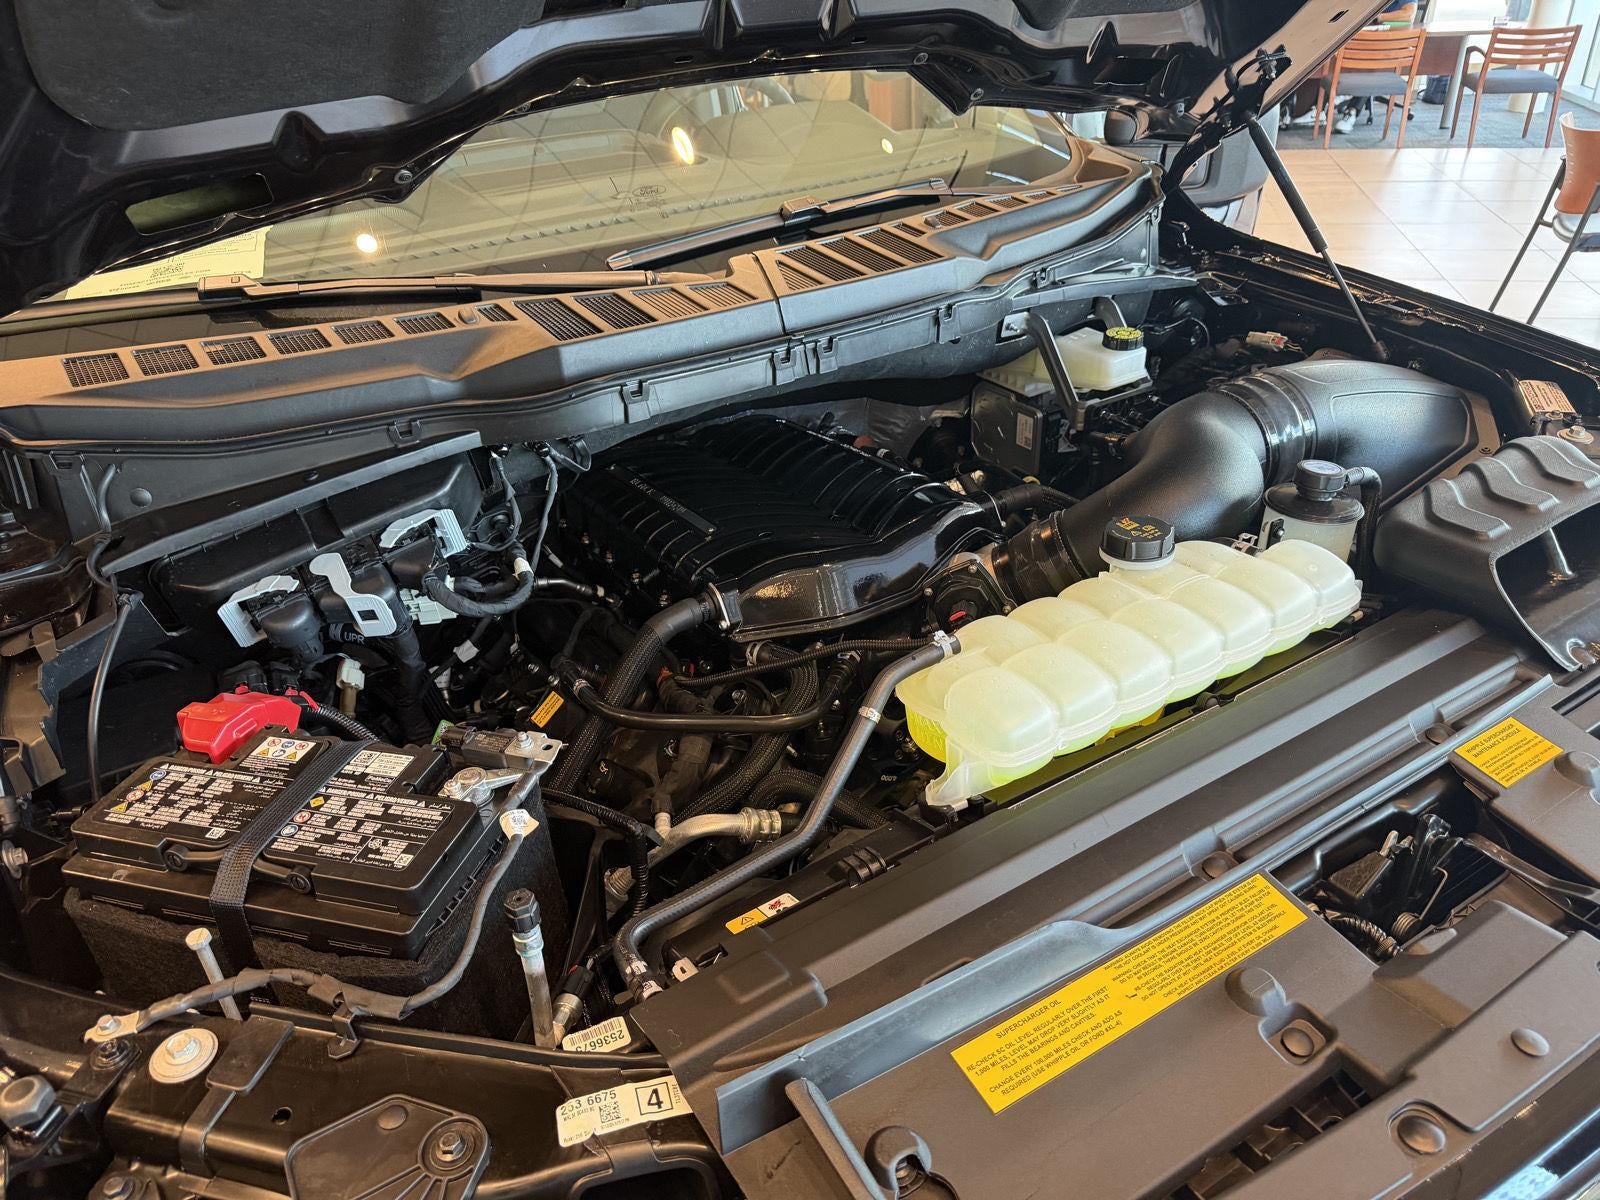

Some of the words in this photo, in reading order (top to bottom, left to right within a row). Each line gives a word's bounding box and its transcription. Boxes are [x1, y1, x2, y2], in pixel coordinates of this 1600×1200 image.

[344, 631, 365, 645] UPR
[966, 1051, 997, 1071] RE-CHECK
[995, 1046, 1005, 1054] SC
[1004, 1040, 1015, 1049] OIL
[1014, 1030, 1033, 1043] LEVEL
[1032, 1011, 1066, 1032] REGULARLY
[1065, 1002, 1081, 1013] OVER
[1080, 995, 1092, 1004] THE
[1091, 986, 1108, 997] FIRST
[995, 1005, 1049, 1038] SUPERCHARGER
[1048, 998, 1061, 1007] OIL
[1009, 1043, 1027, 1056] LEVEL
[1027, 1035, 1040, 1045] MAY
[1039, 1026, 1056, 1038] DROP
[1055, 1017, 1070, 1028] VERY
[1070, 1002, 1096, 1019] SLIGHTLY
[989, 1075, 1014, 1092] CHANGE
[1013, 1064, 1033, 1077] EVERY
[1053, 1041, 1070, 1053] MILES
[1070, 1029, 1089, 1043] CHECK
[1089, 1022, 1102, 1031] AND
[1101, 1014, 1114, 1024] ADD
[1000, 1058, 1017, 1070] FILLS
[1017, 1051, 1029, 1060] THE
[1029, 1034, 1058, 1053] BEARINGS
[1057, 1027, 1070, 1036] AND
[1001, 1075, 1031, 1095] REQUIRED
[1045, 1051, 1070, 1068] WHIPPLE
[1069, 1045, 1080, 1053] OIL
[1079, 1039, 1089, 1047] OR
[1088, 1030, 1104, 1042] FORD
[587, 1090, 617, 1106] 6675
[647, 1087, 664, 1110] 4
